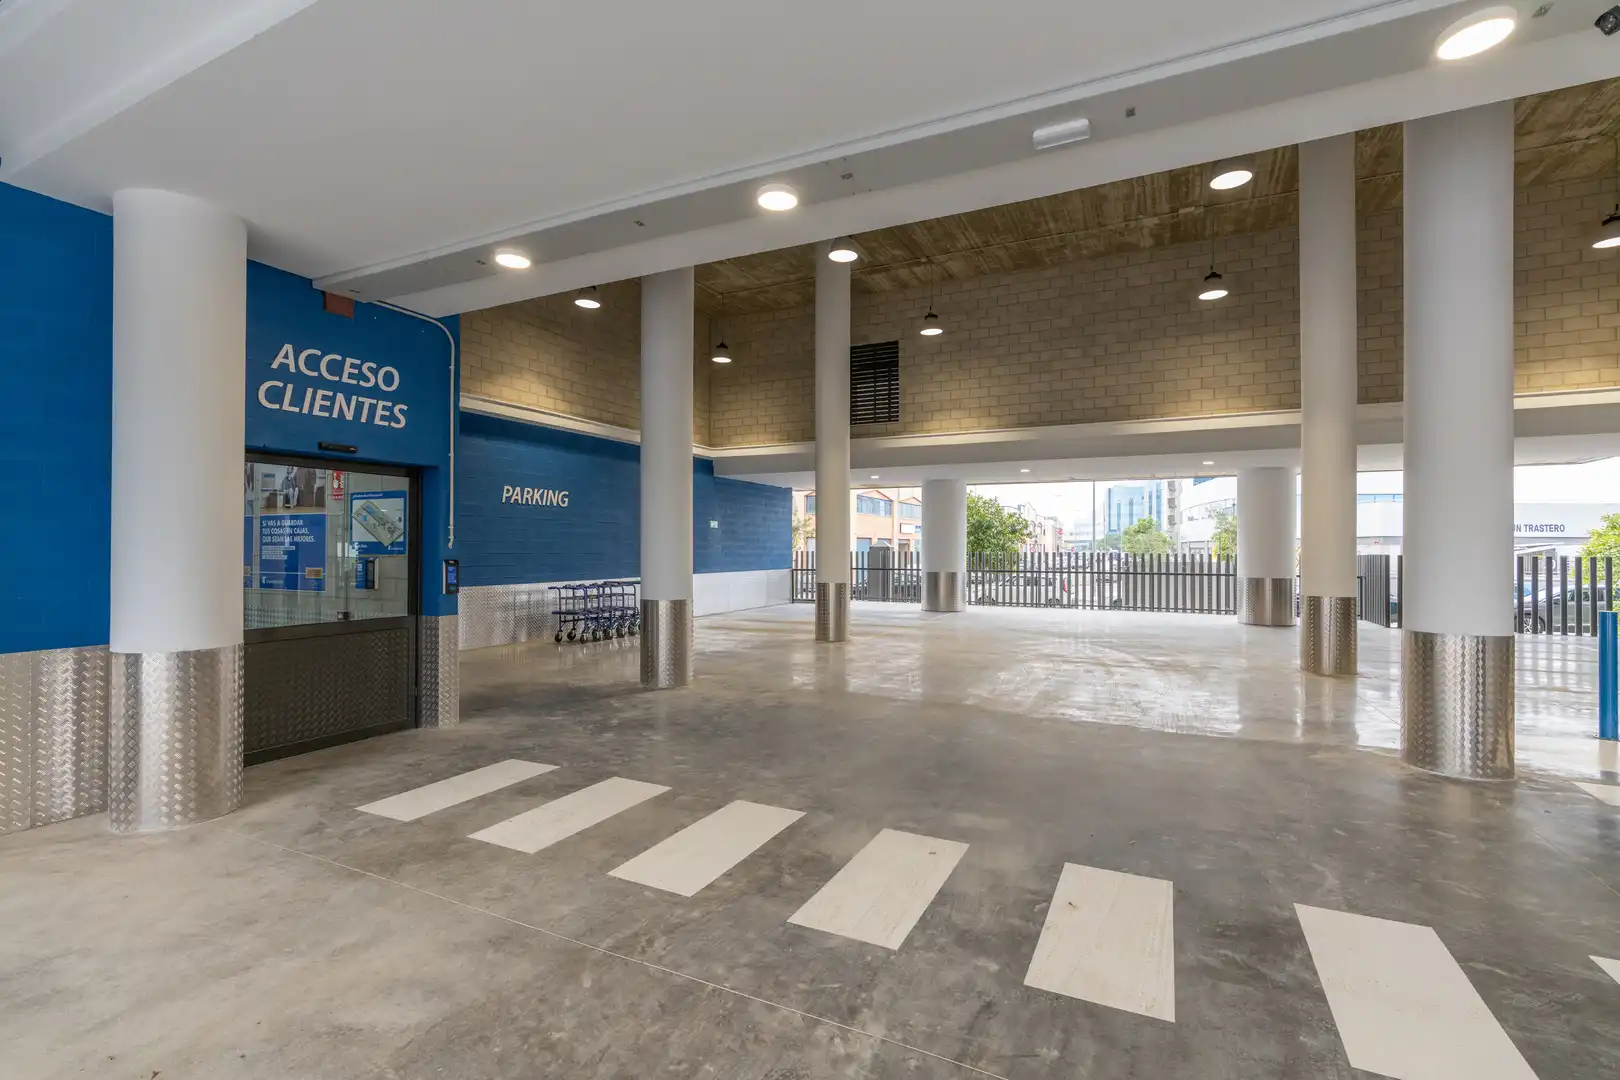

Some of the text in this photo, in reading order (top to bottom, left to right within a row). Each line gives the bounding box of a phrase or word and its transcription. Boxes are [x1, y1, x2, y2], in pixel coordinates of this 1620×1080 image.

[270, 343, 400, 392] ACCESO
[257, 380, 409, 429] CLIENTES
[501, 485, 569, 508] PARKING
[1524, 524, 1565, 532] TRASTERO
